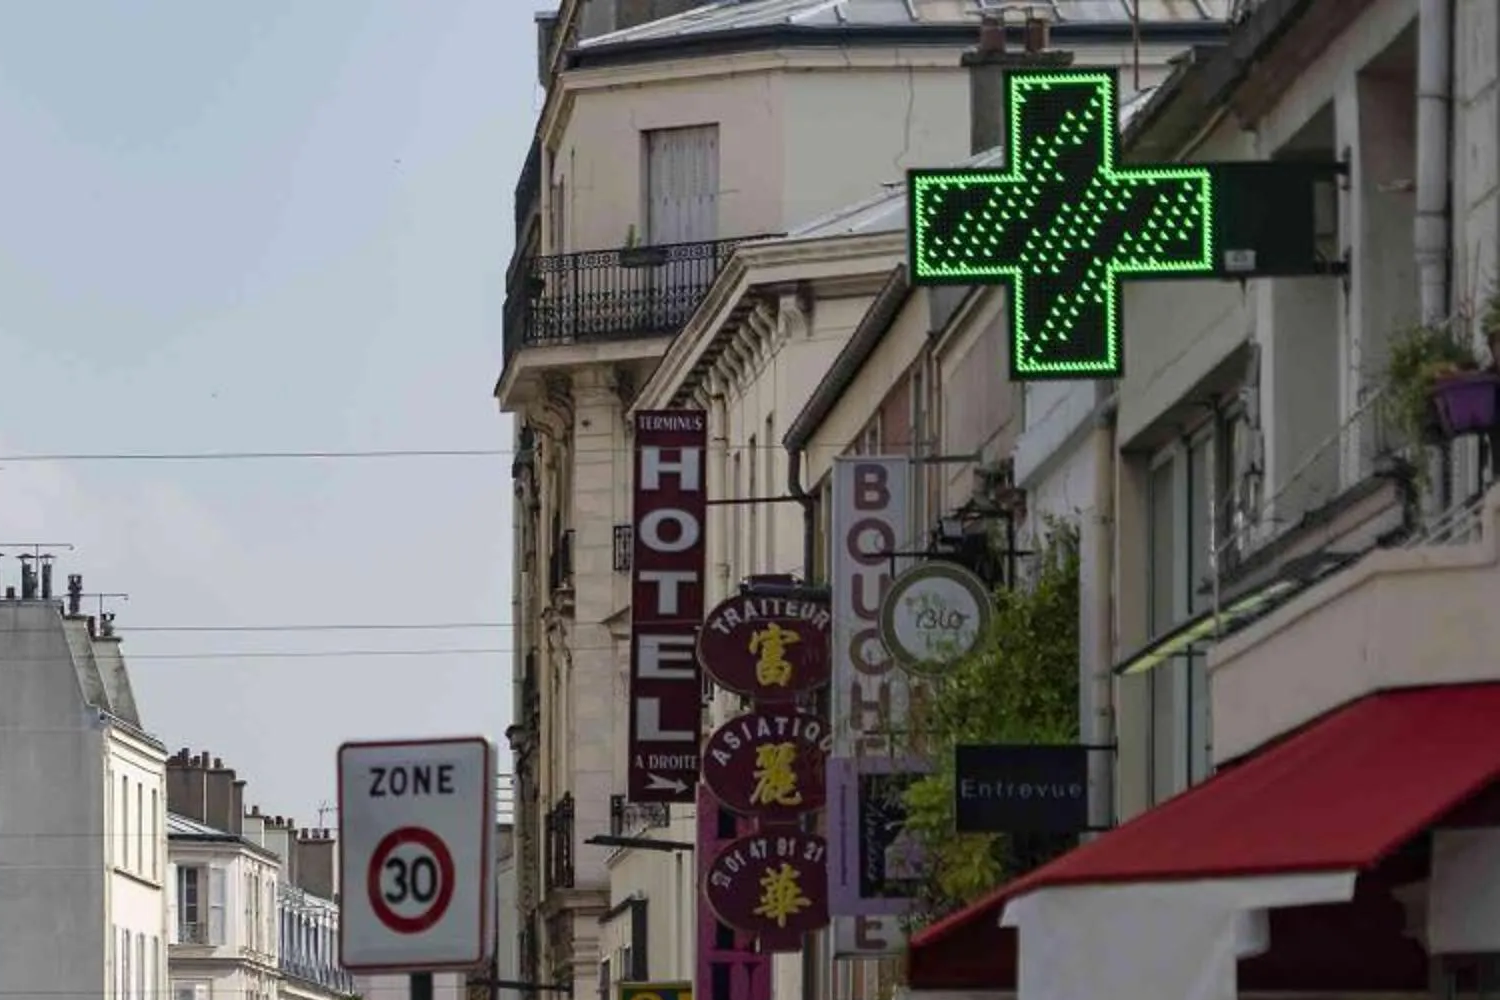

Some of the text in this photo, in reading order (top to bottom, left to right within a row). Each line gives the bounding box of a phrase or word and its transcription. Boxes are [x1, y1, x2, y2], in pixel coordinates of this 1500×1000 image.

[638, 416, 702, 431] TERMINUS
[636, 444, 700, 742] HOTEL
[711, 599, 831, 635] TRAITEUR
[712, 716, 832, 767] ASIATIQU
[648, 753, 698, 769] DROITE
[368, 764, 455, 798] ZONE
[961, 778, 1083, 799] Entrevue
[385, 854, 438, 905] 30
